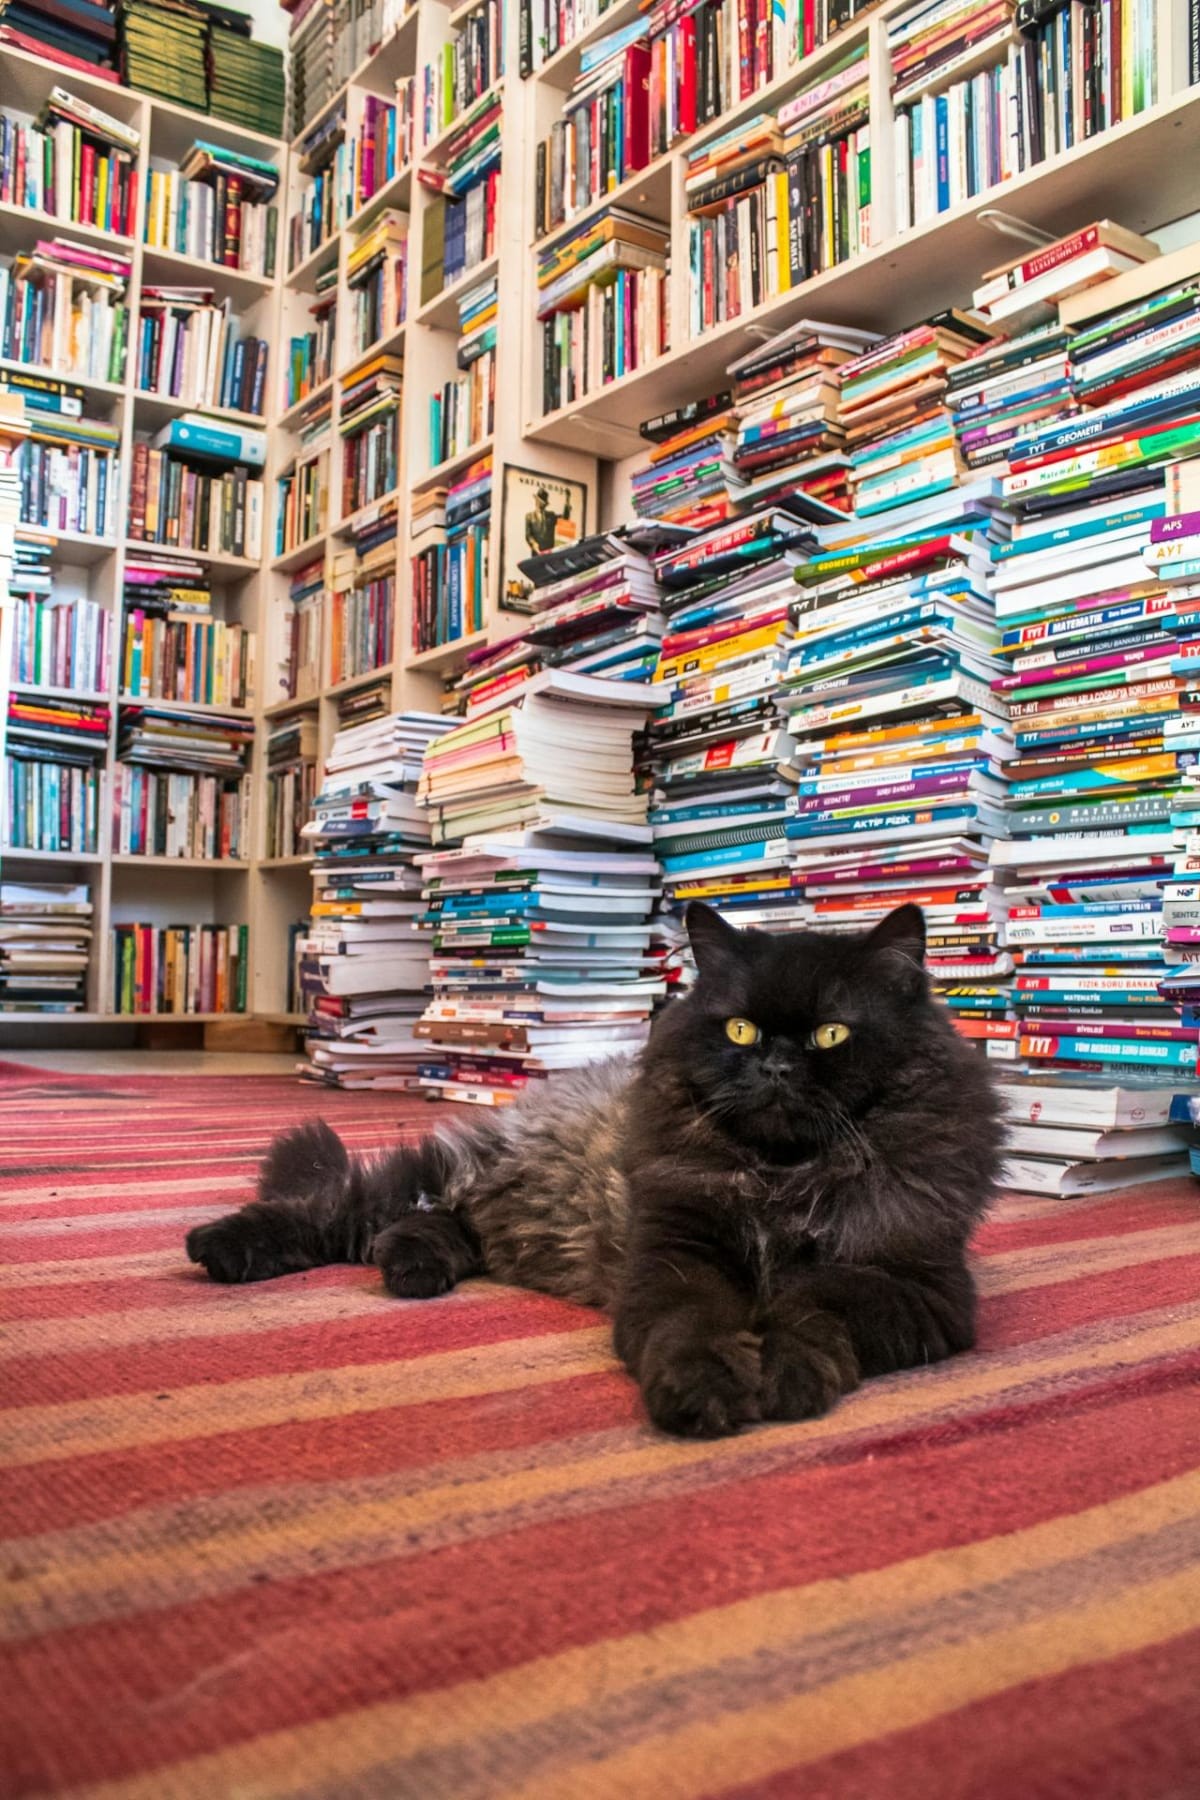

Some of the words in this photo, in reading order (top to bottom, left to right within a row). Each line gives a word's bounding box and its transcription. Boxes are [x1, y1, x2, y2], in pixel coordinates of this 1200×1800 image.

[1029, 442, 1046, 455] TYT
[1056, 422, 1103, 445] GEOMETRİ
[1162, 520, 1182, 532] MPS
[1156, 544, 1183, 558] AYT
[817, 554, 859, 571] GEOMETRİ
[793, 600, 810, 612] TYT
[1027, 627, 1042, 639] TYT
[1052, 612, 1103, 632] MATEMATİK
[1178, 614, 1195, 626] AYT
[812, 678, 849, 692] GEOMETRİ
[1147, 680, 1176, 693] BANKASI
[1181, 720, 1195, 729] AYT
[1023, 733, 1038, 742] TYT
[853, 817, 884, 829] AKTİF
[885, 814, 911, 826] FİZİK
[1171, 911, 1199, 919] SENTEZ
[1182, 953, 1200, 962] AYT
[1026, 980, 1039, 989] AYT
[1063, 993, 1101, 1002] MATEMATİK
[1027, 1023, 1040, 1031] TYT
[1029, 1037, 1052, 1054] TYT
